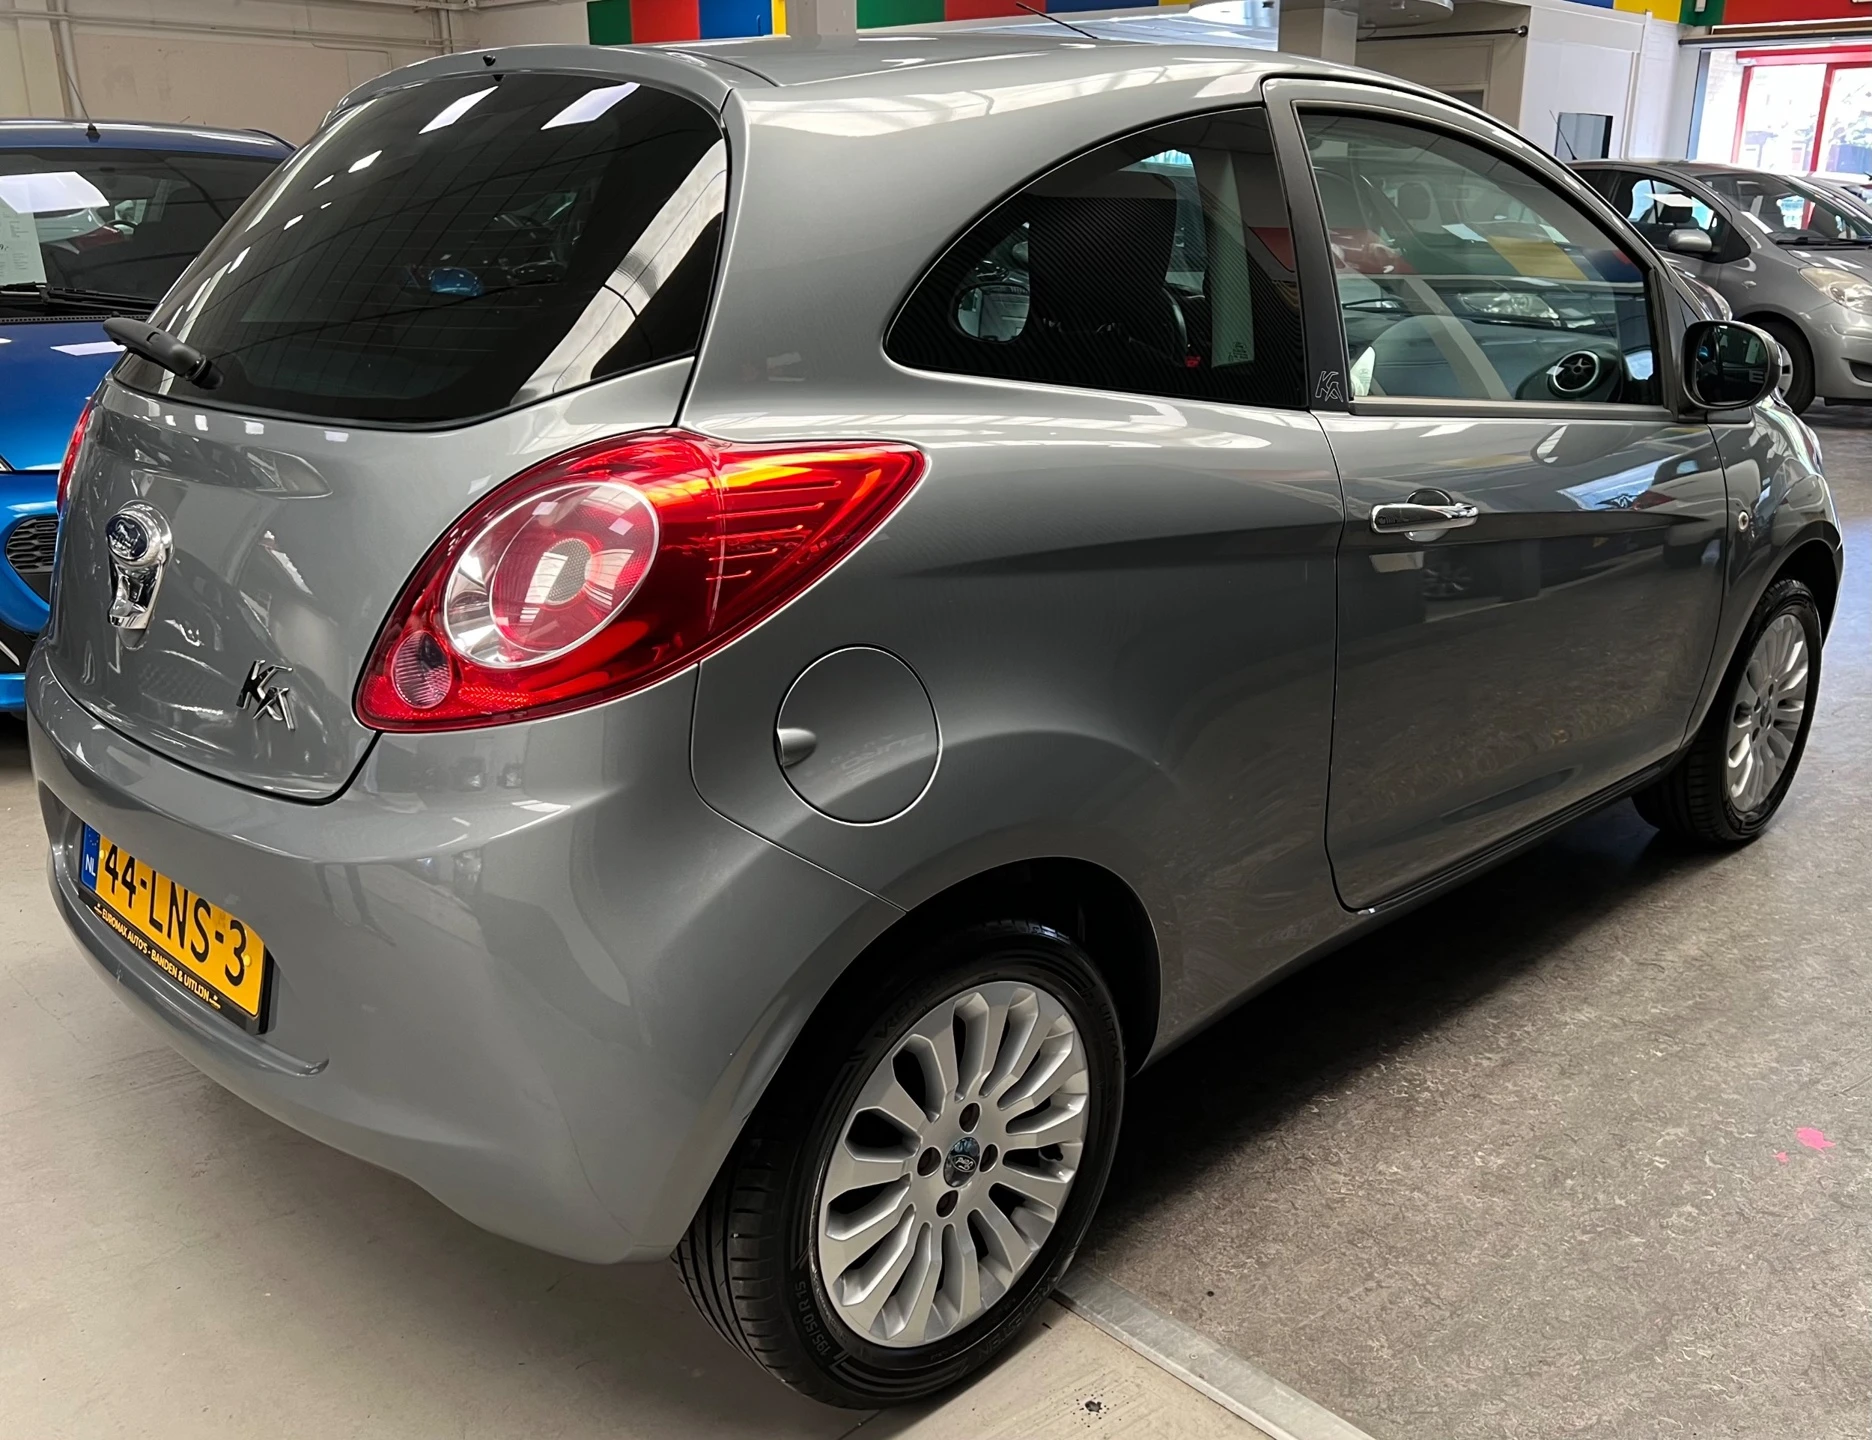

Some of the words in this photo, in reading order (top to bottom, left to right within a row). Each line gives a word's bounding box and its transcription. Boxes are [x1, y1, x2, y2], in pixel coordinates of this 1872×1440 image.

[85, 854, 96, 877] NL
[104, 844, 247, 987] 44-LNS-3
[102, 908, 128, 937] EUROMAX
[127, 931, 149, 954] AUTO'S
[151, 952, 178, 978] BANDEN
[177, 970, 184, 982] &
[794, 1281, 807, 1301] 15
[802, 1315, 832, 1356] 195/50
